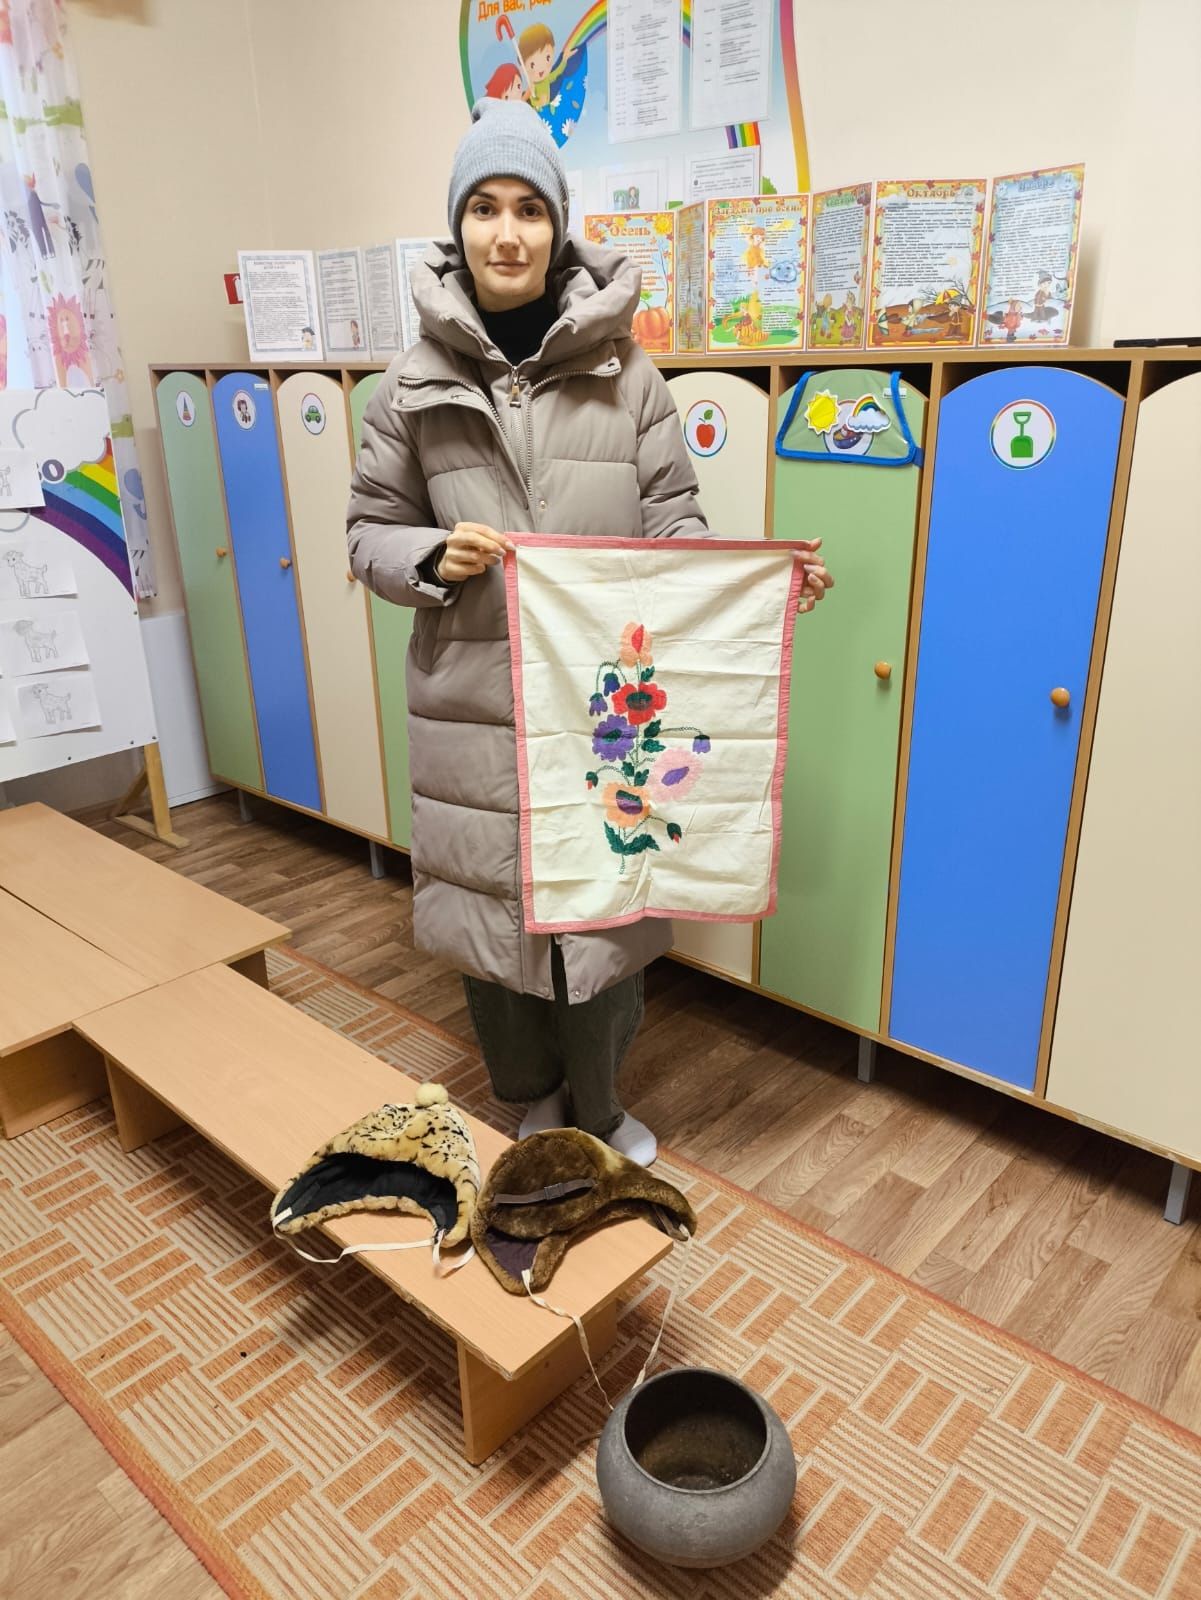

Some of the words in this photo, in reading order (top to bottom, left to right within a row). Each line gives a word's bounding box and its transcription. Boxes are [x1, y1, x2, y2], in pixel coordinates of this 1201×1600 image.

[478, 1, 499, 22] Для
[503, 0, 525, 12] вас,
[906, 189, 956, 200] Октябрь
[755, 206, 773, 215] про
[610, 225, 651, 237] Осень
